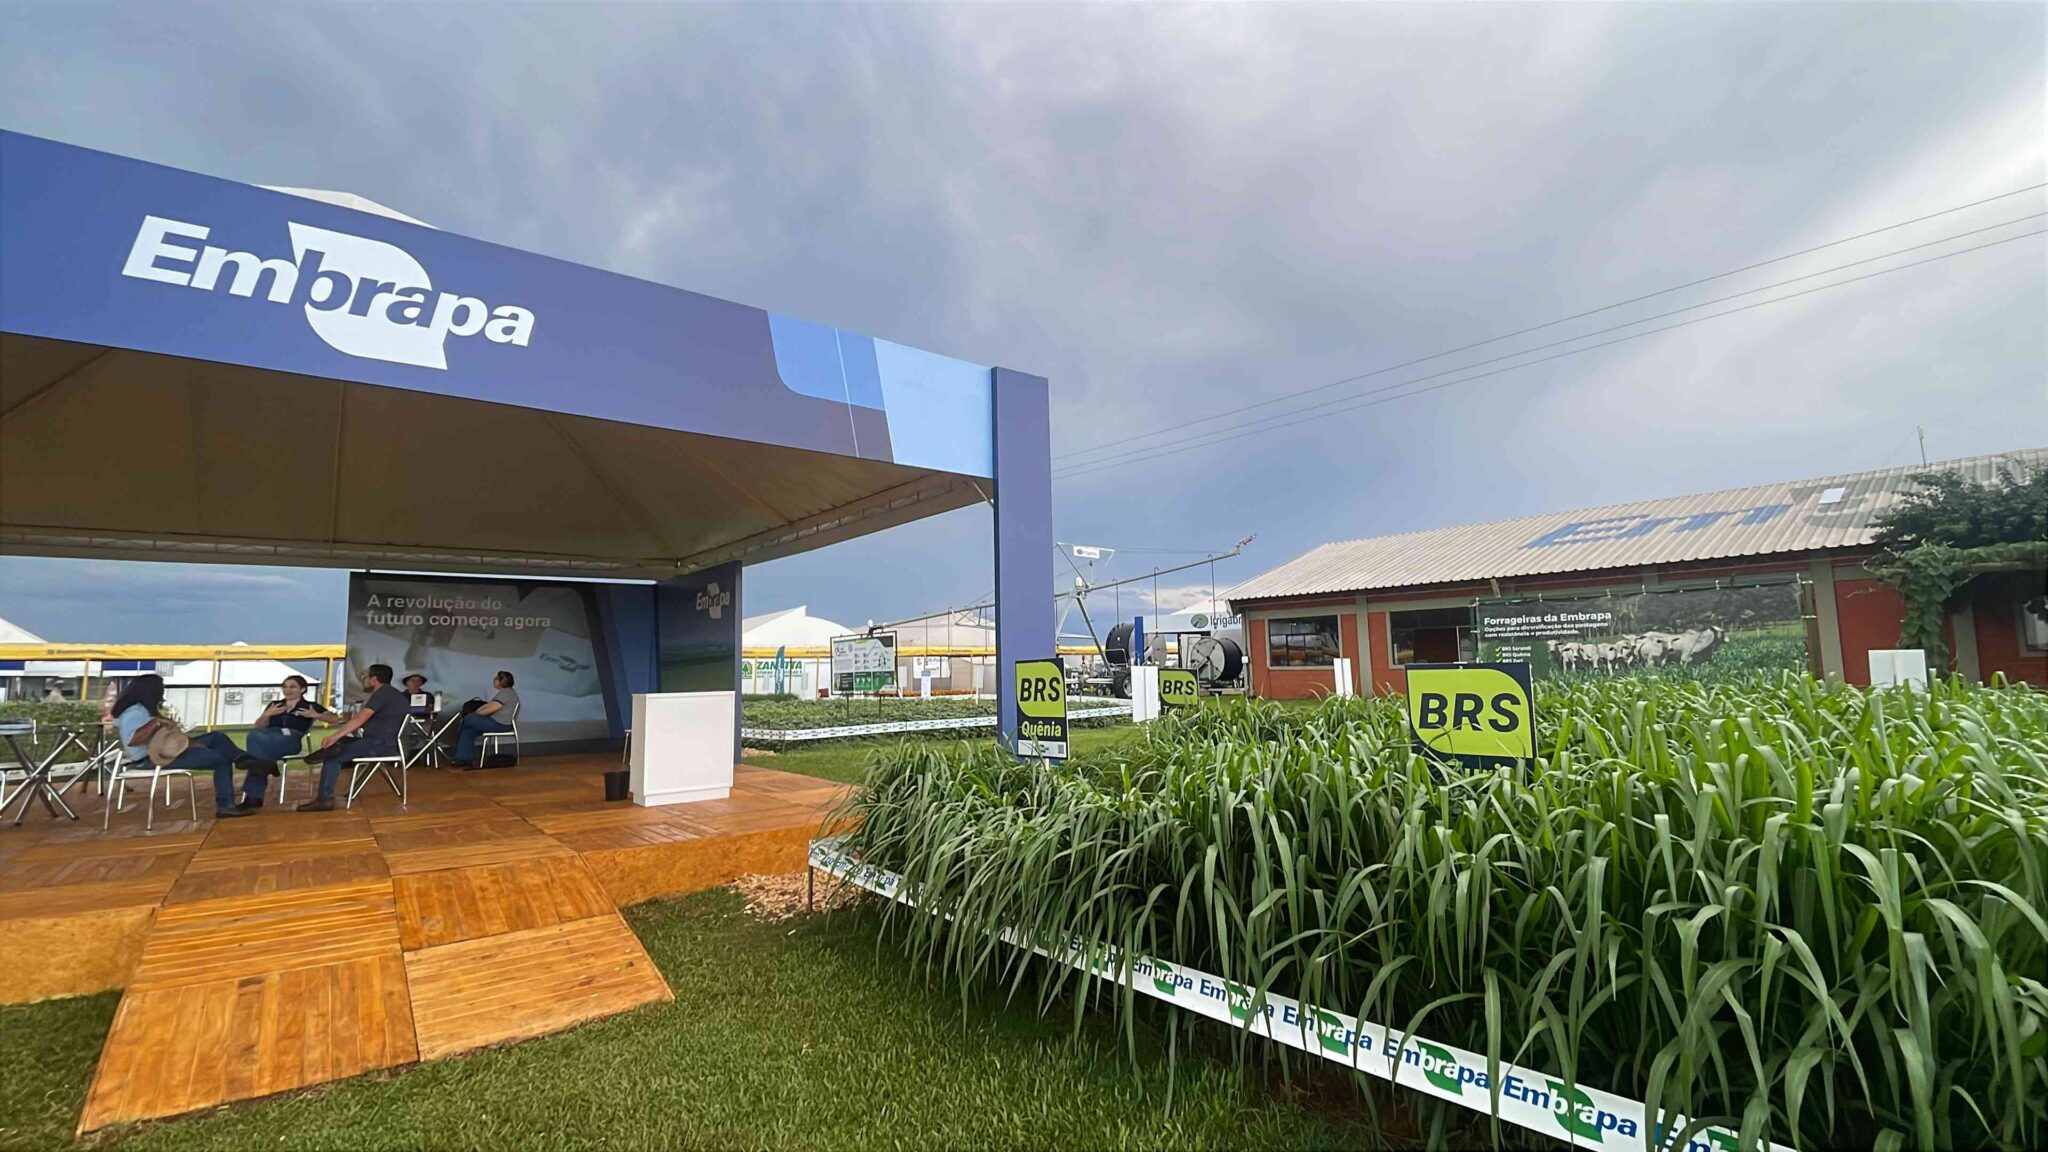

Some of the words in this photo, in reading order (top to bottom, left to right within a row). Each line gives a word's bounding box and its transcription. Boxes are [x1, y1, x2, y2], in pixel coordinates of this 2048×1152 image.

[122, 215, 535, 347] Embrapa
[367, 594, 381, 607] A
[387, 595, 477, 611] revolução
[481, 597, 501, 610] do
[367, 611, 423, 625] futuro
[429, 615, 499, 629] começa
[504, 616, 551, 630] agora
[1484, 614, 1542, 626] Forrageiras
[1544, 613, 1558, 622] da
[1560, 612, 1612, 622] Embrapa
[1020, 676, 1061, 702] BRS
[1162, 679, 1195, 695] BRS
[1419, 692, 1521, 733] BRS
[1021, 720, 1062, 737] Quênia
[1383, 1038, 1490, 1090] Embrapa
[1502, 1075, 1638, 1139] Embrapa
